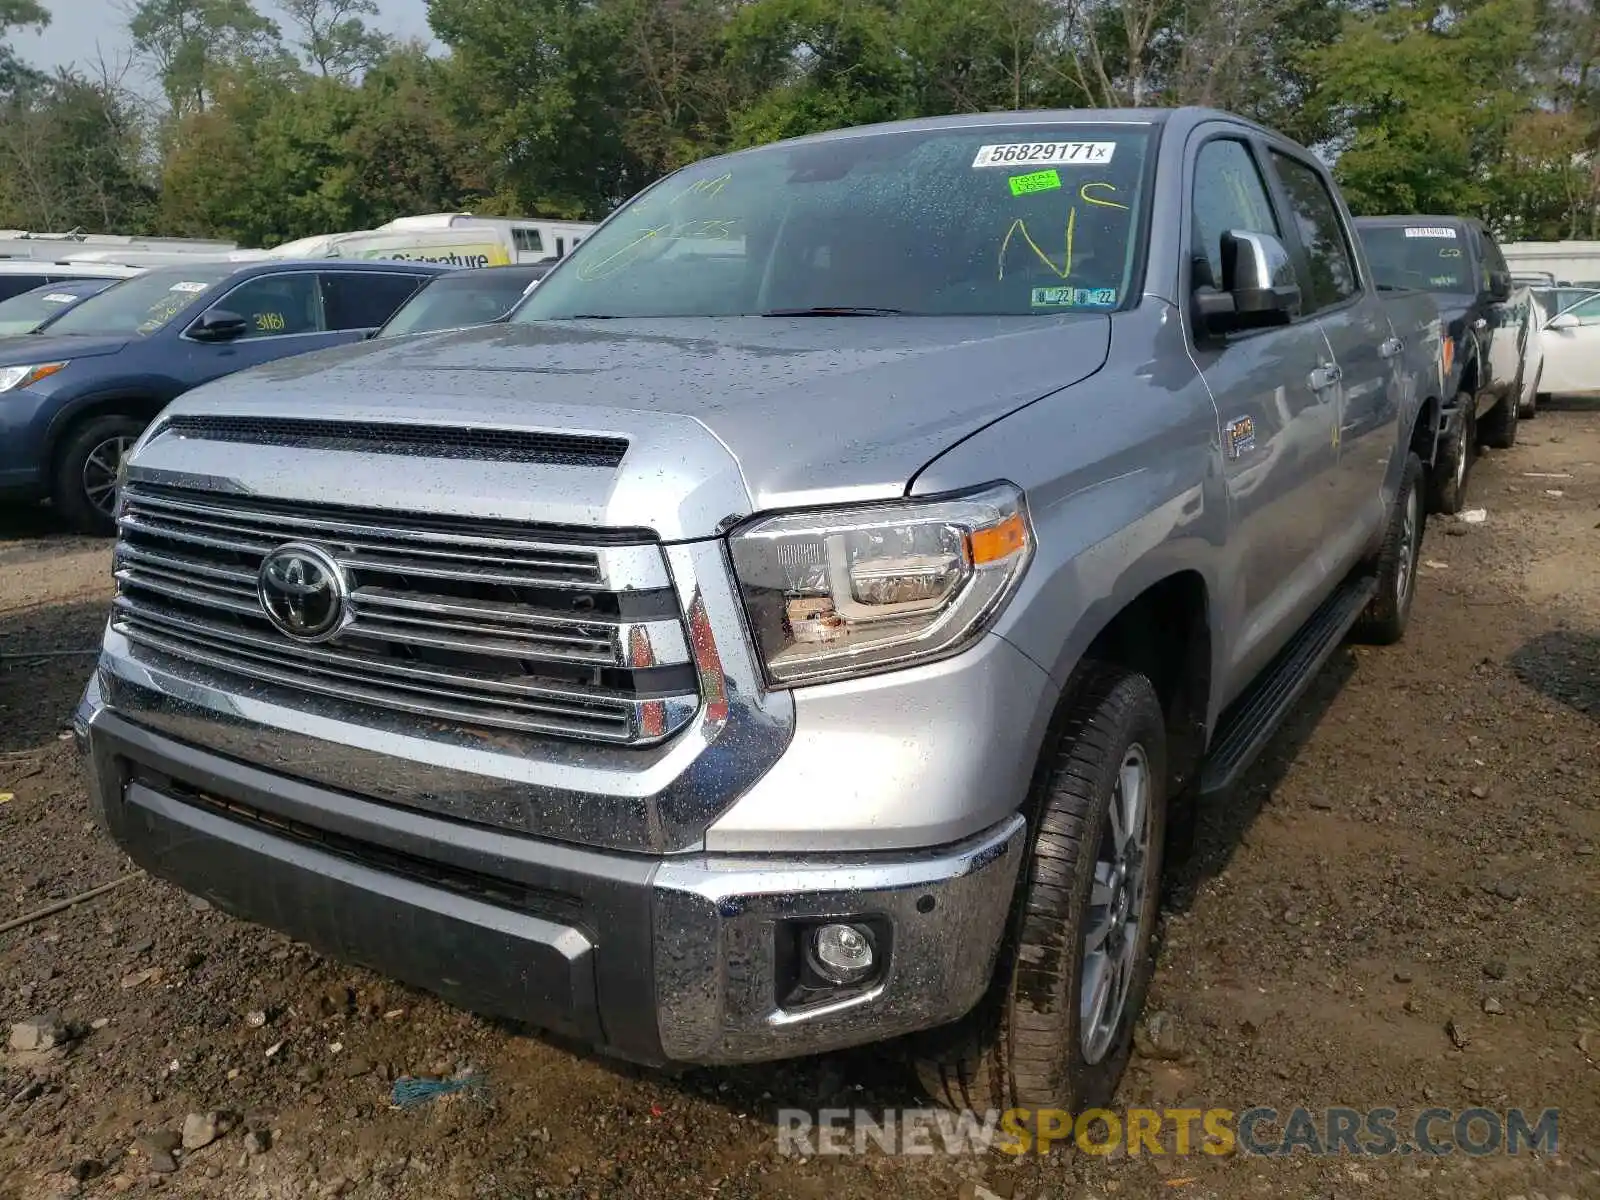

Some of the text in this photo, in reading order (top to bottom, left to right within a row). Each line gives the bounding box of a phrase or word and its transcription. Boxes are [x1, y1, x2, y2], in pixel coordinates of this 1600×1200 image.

[392, 251, 489, 270] ature
[1057, 289, 1069, 303] 22
[1099, 290, 1112, 304] 22
